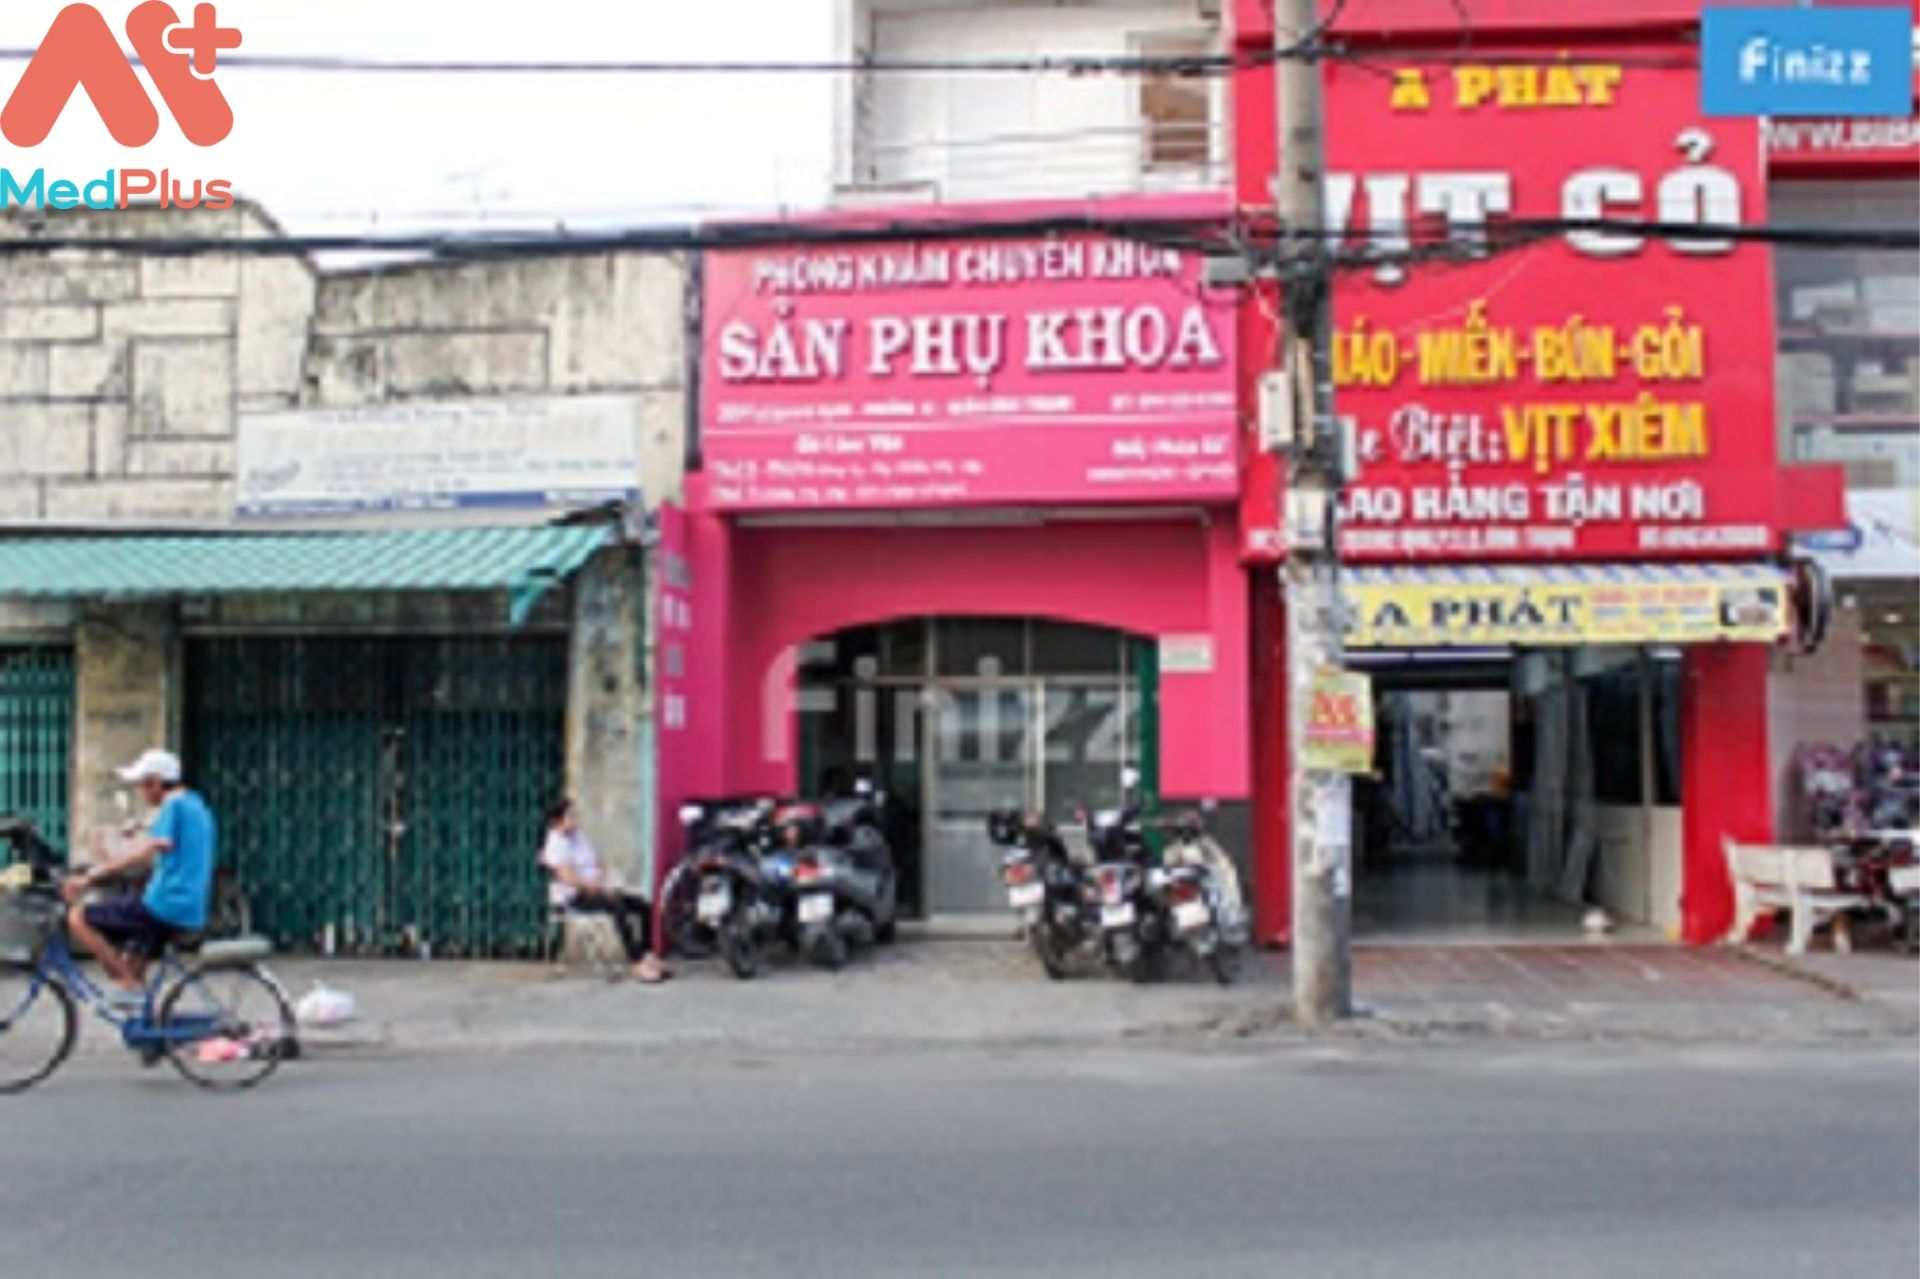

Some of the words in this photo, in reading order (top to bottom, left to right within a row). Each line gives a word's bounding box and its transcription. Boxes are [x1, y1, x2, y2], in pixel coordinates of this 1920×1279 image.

[720, 297, 846, 379] SẢN
[868, 314, 1004, 390] PHỤ
[1023, 304, 1221, 370] KHOA
[1412, 470, 1530, 521] HÀNG
[1536, 471, 1621, 527] TẬN
